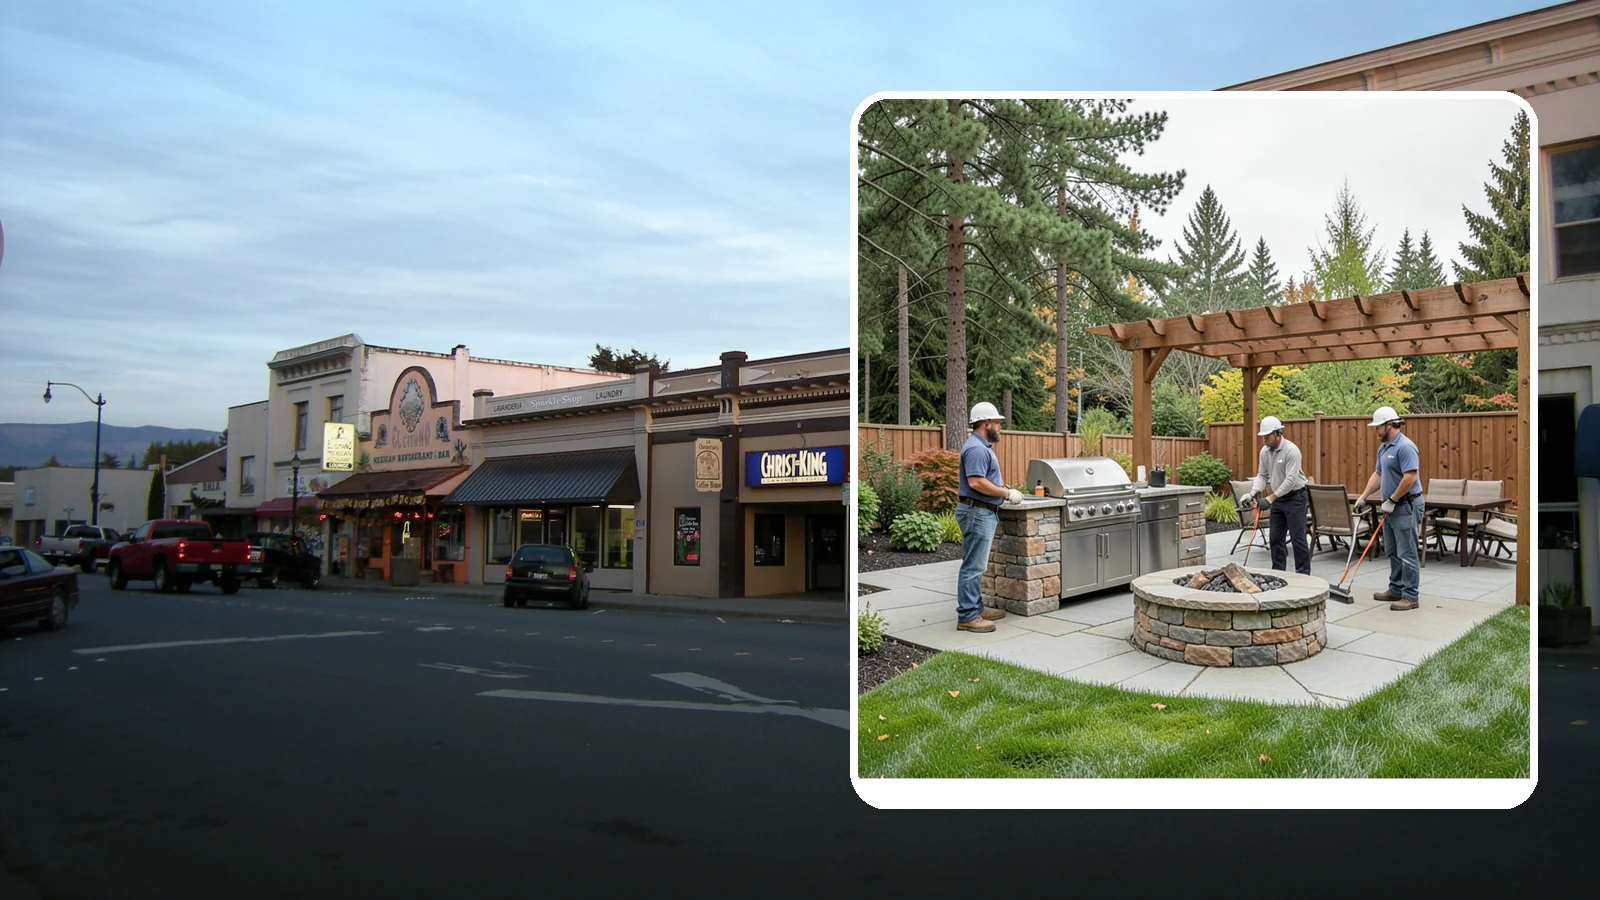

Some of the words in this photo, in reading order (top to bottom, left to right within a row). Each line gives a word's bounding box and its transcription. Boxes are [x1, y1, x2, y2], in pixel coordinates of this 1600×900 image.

[561, 394, 582, 405] Shop
[595, 389, 623, 399] LAUNDRY
[493, 402, 522, 412] LAVANDERIA
[374, 455, 396, 463] MEXICAN
[398, 451, 433, 461] RESTAURANT
[438, 450, 450, 459] BAR
[761, 452, 798, 478] CHRIST
[799, 450, 827, 476] KING
